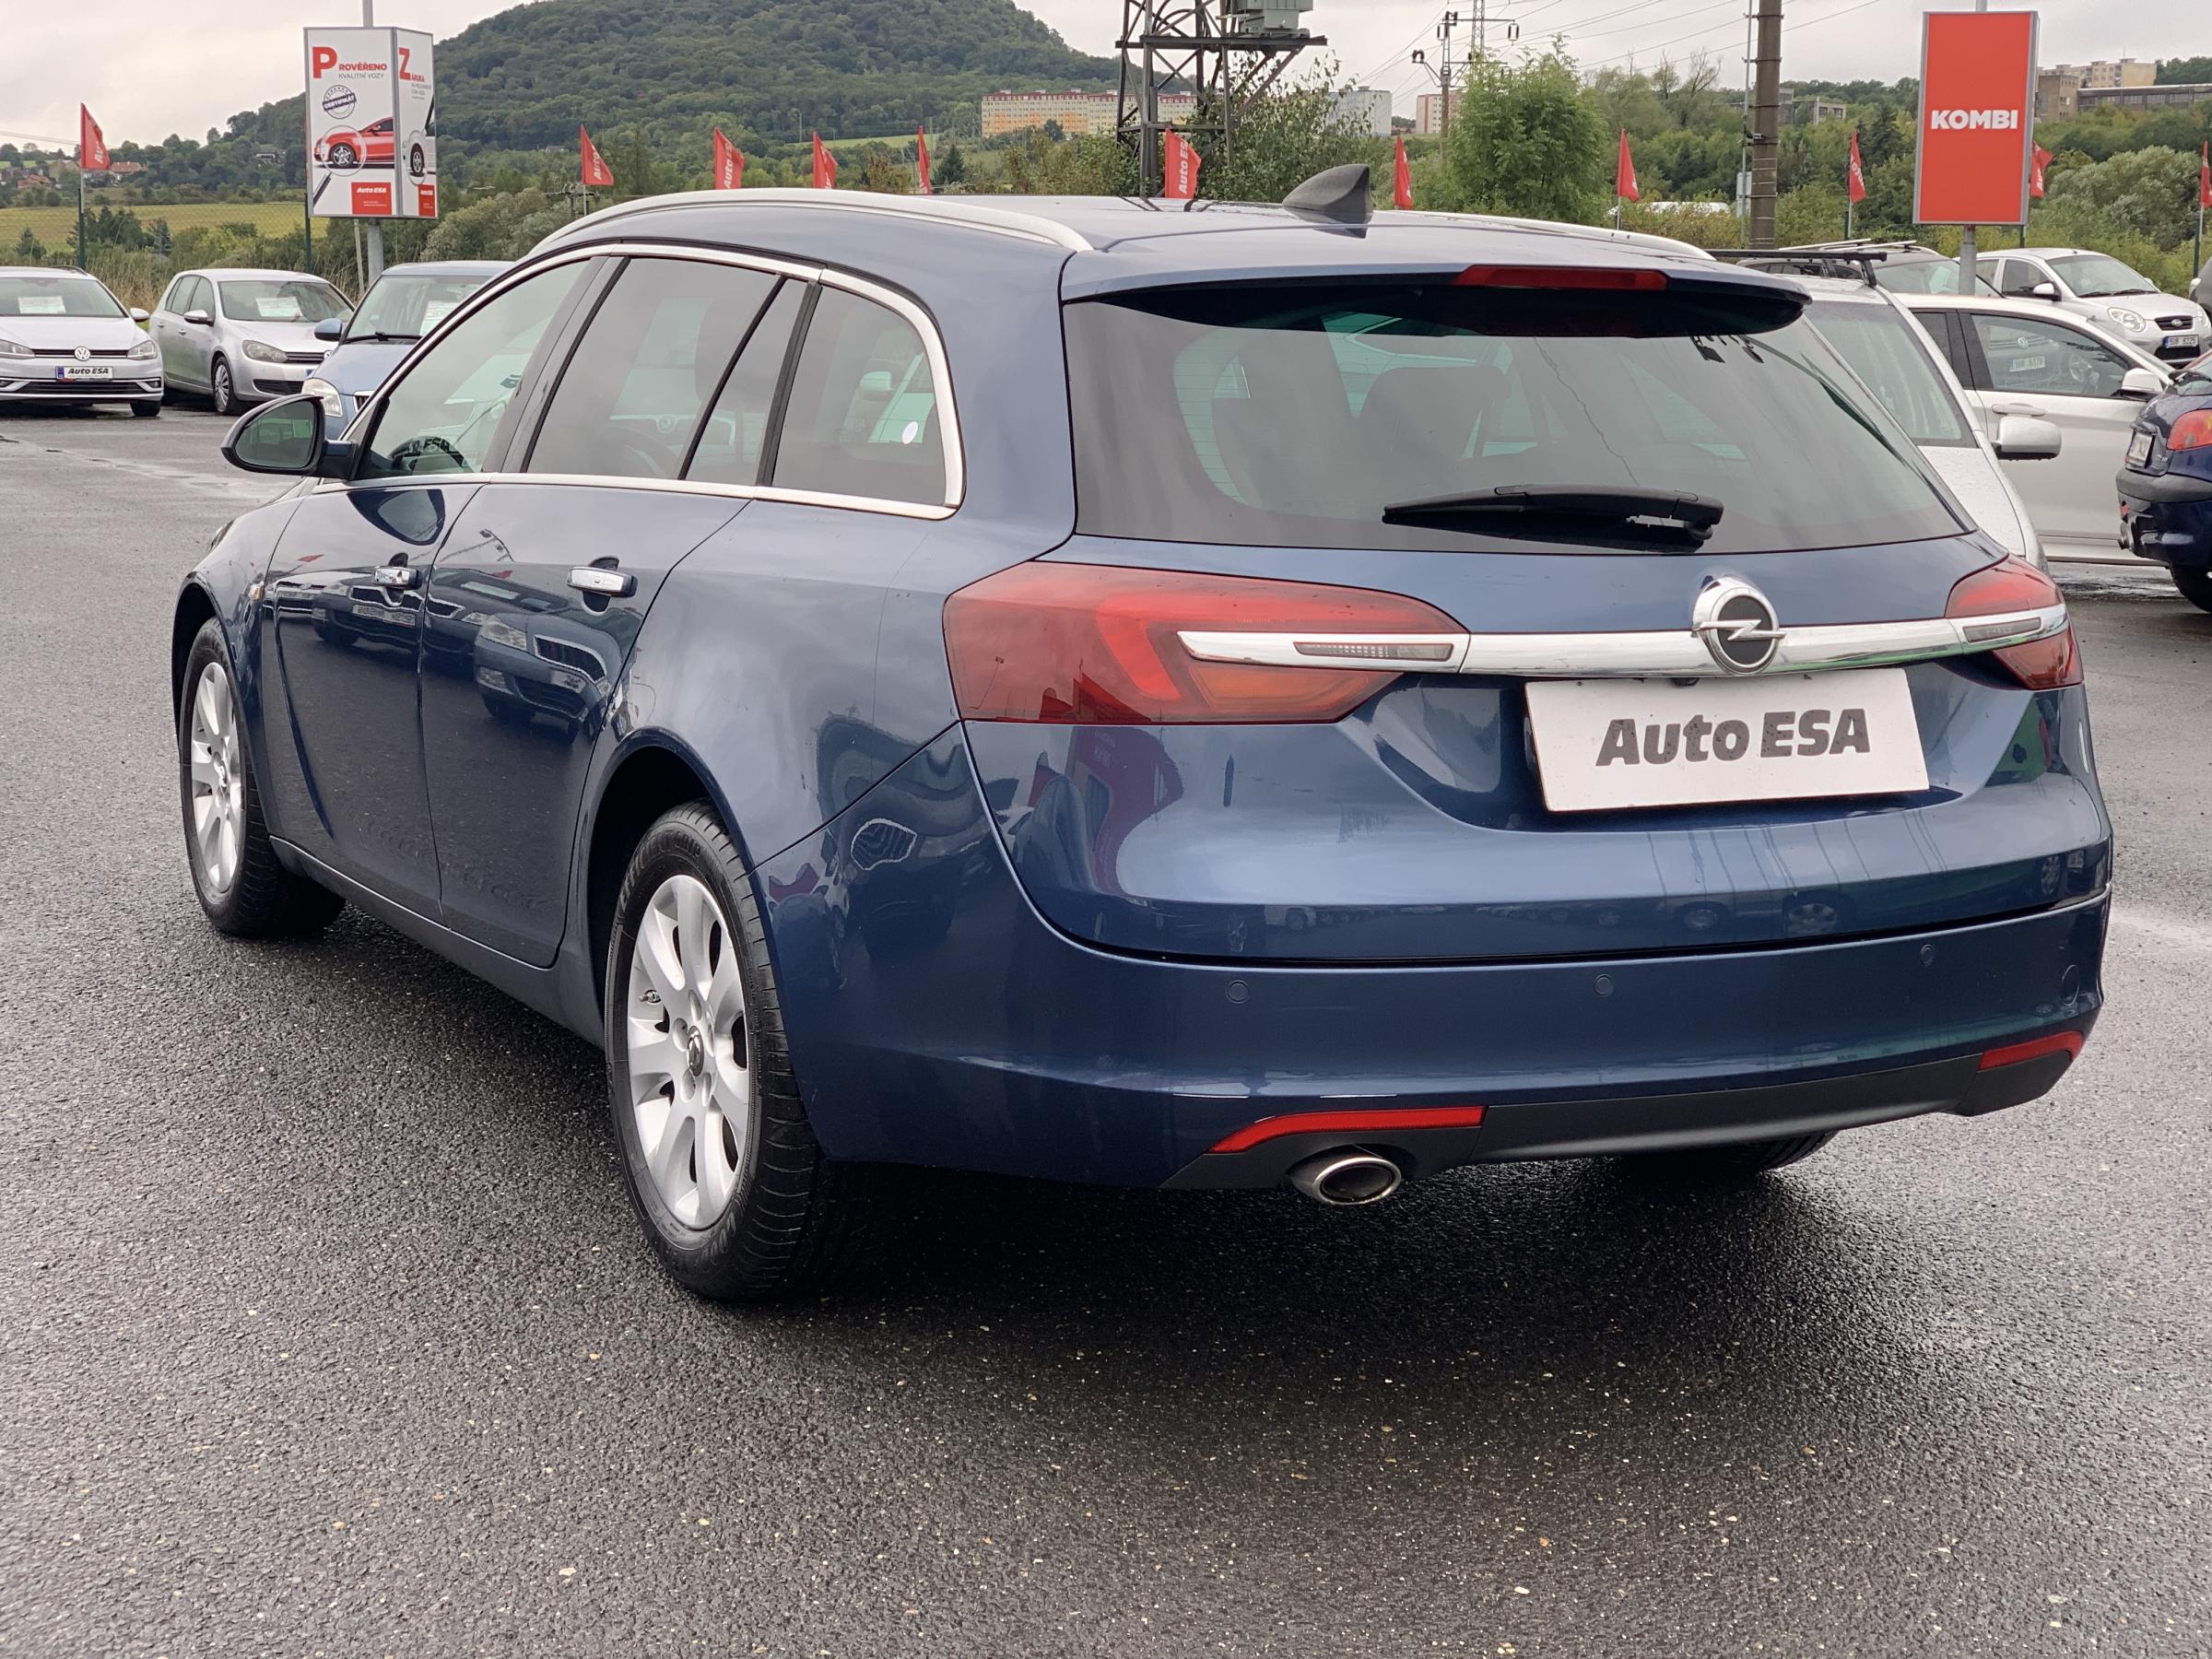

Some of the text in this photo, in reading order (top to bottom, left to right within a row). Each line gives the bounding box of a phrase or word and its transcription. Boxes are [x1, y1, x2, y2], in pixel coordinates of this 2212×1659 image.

[1931, 109, 2019, 130] KOMBI
[1178, 160, 1189, 194] Auto
[1594, 708, 1871, 767] Auto ESA
